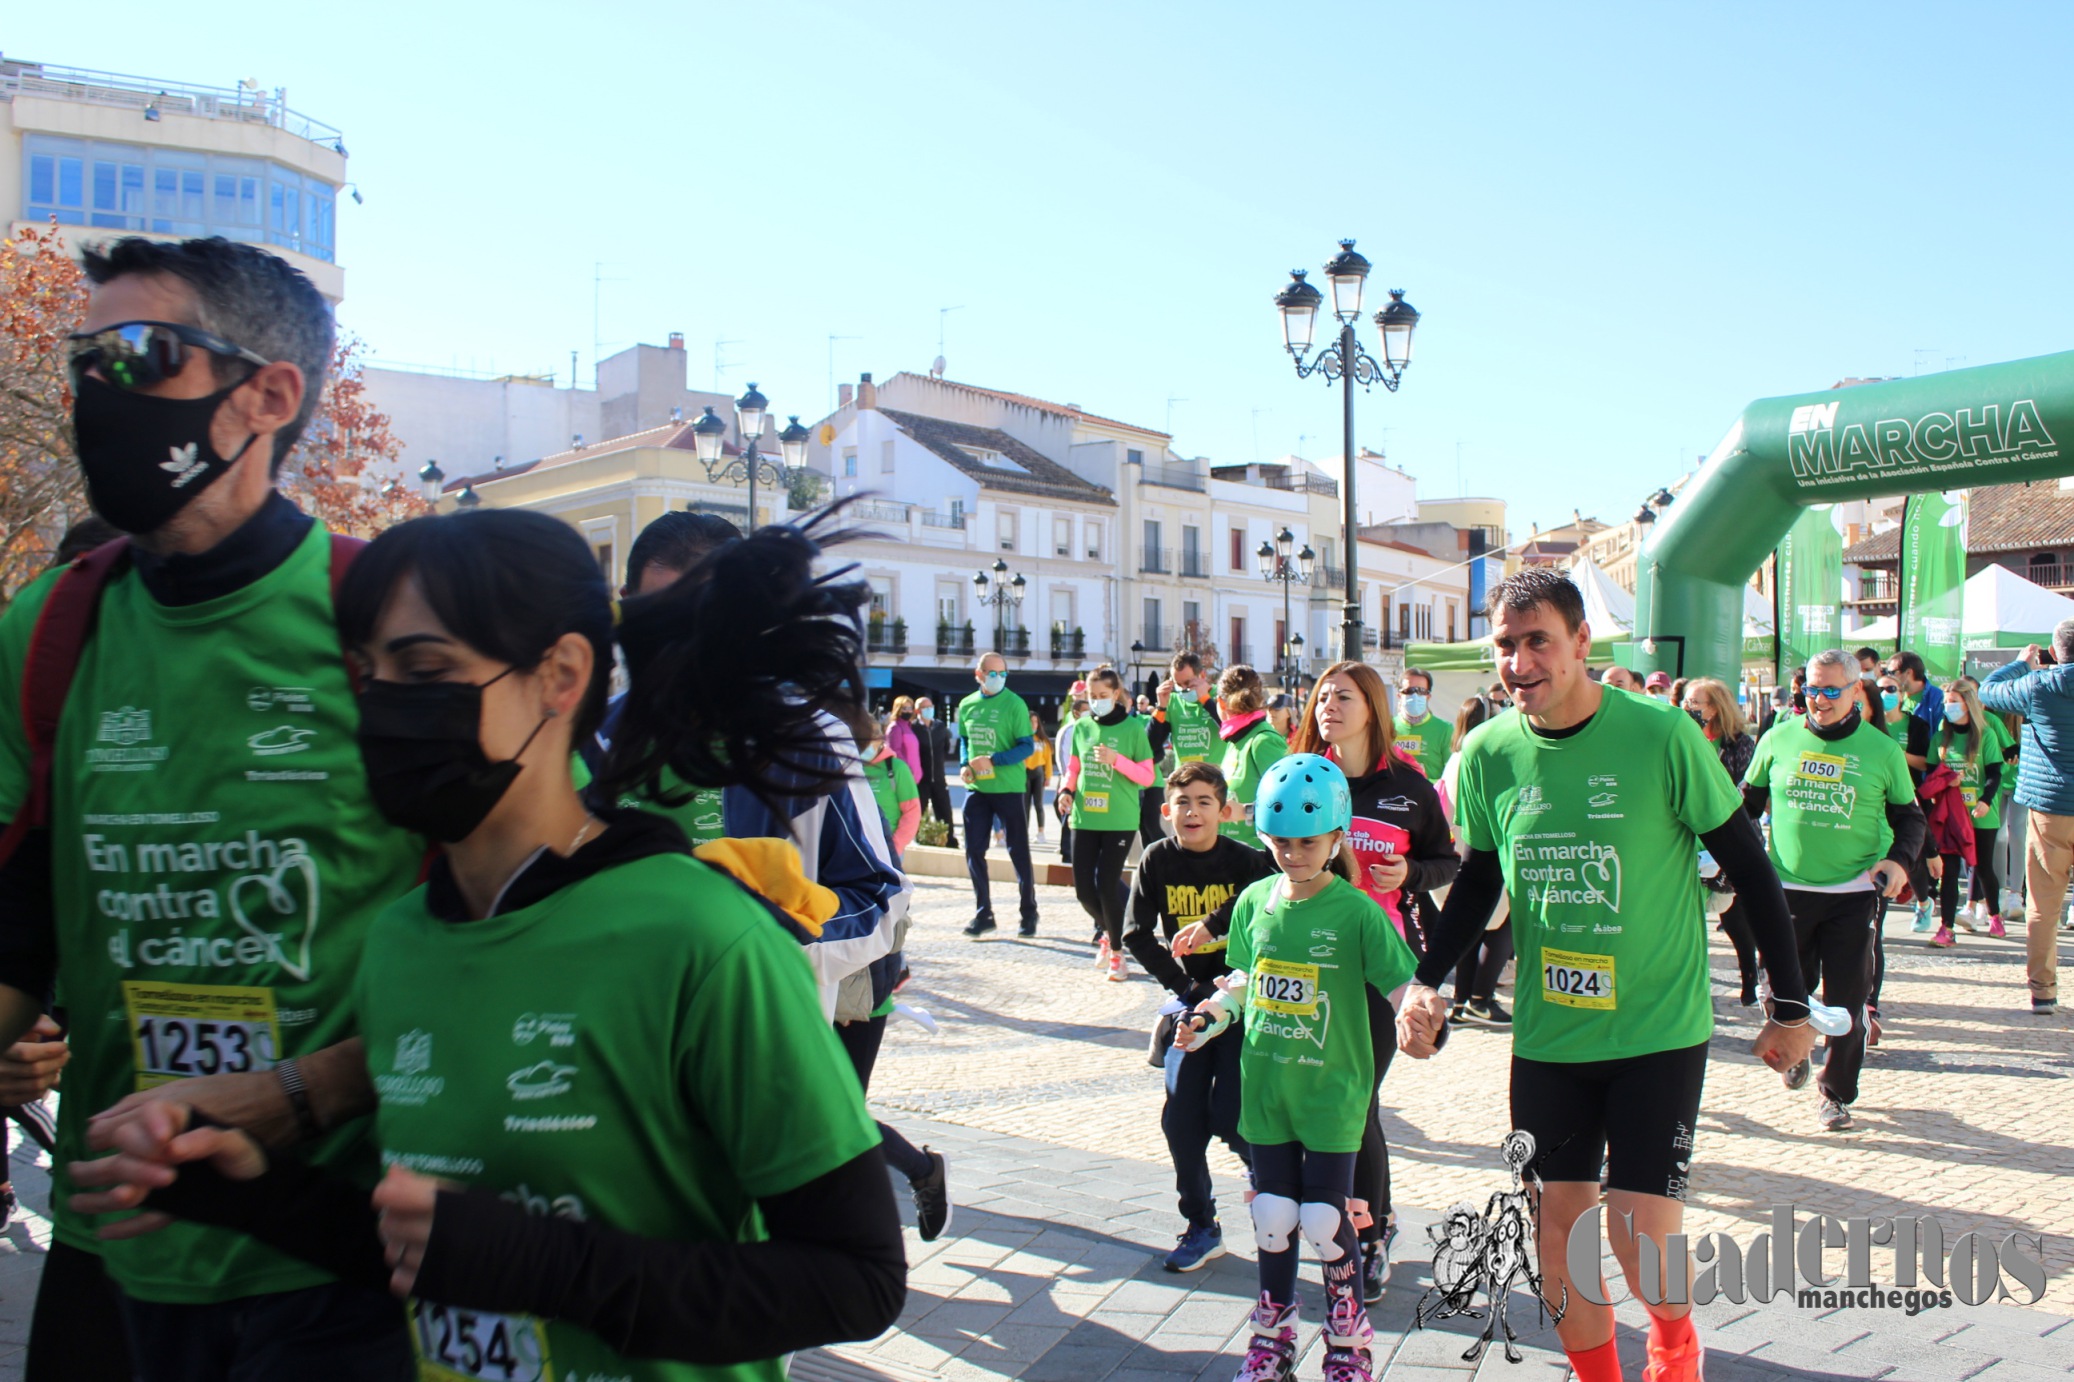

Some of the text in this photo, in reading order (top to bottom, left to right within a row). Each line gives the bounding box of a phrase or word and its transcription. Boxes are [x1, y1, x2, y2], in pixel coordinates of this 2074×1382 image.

[1789, 402, 1839, 434] EN
[1788, 400, 2055, 477] MARCHA
[1798, 479, 1816, 487] Una
[1817, 473, 1856, 485] iniciativa
[1880, 465, 1930, 477] Asociación
[1930, 460, 1974, 472] Española
[1975, 456, 2009, 466] Contra
[2010, 454, 2020, 462] el
[2021, 450, 2059, 461] Cáncer
[1913, 505, 1921, 520] no
[1784, 529, 1792, 556] cua
[1911, 525, 1919, 570] cuando
[1962, 636, 1993, 649] Cáncer
[1801, 760, 1835, 777] 1050
[1785, 789, 1826, 801] contra
[1786, 775, 1855, 793] En marcha
[1787, 798, 1844, 814] el cáncer
[83, 830, 309, 873] En marcha
[1514, 840, 1616, 860] En marcha
[1520, 864, 1576, 882] contra
[98, 884, 219, 921] contra
[1165, 884, 1235, 915] BATMAN
[108, 929, 284, 968] el cáncer
[1258, 974, 1303, 1002] 1023
[1545, 965, 1600, 995] 1024
[137, 1018, 253, 1076] 1253
[1323, 1259, 1357, 1281] MINNIE
[1256, 1339, 1275, 1348] FILA
[1331, 1353, 1350, 1362] FILA
